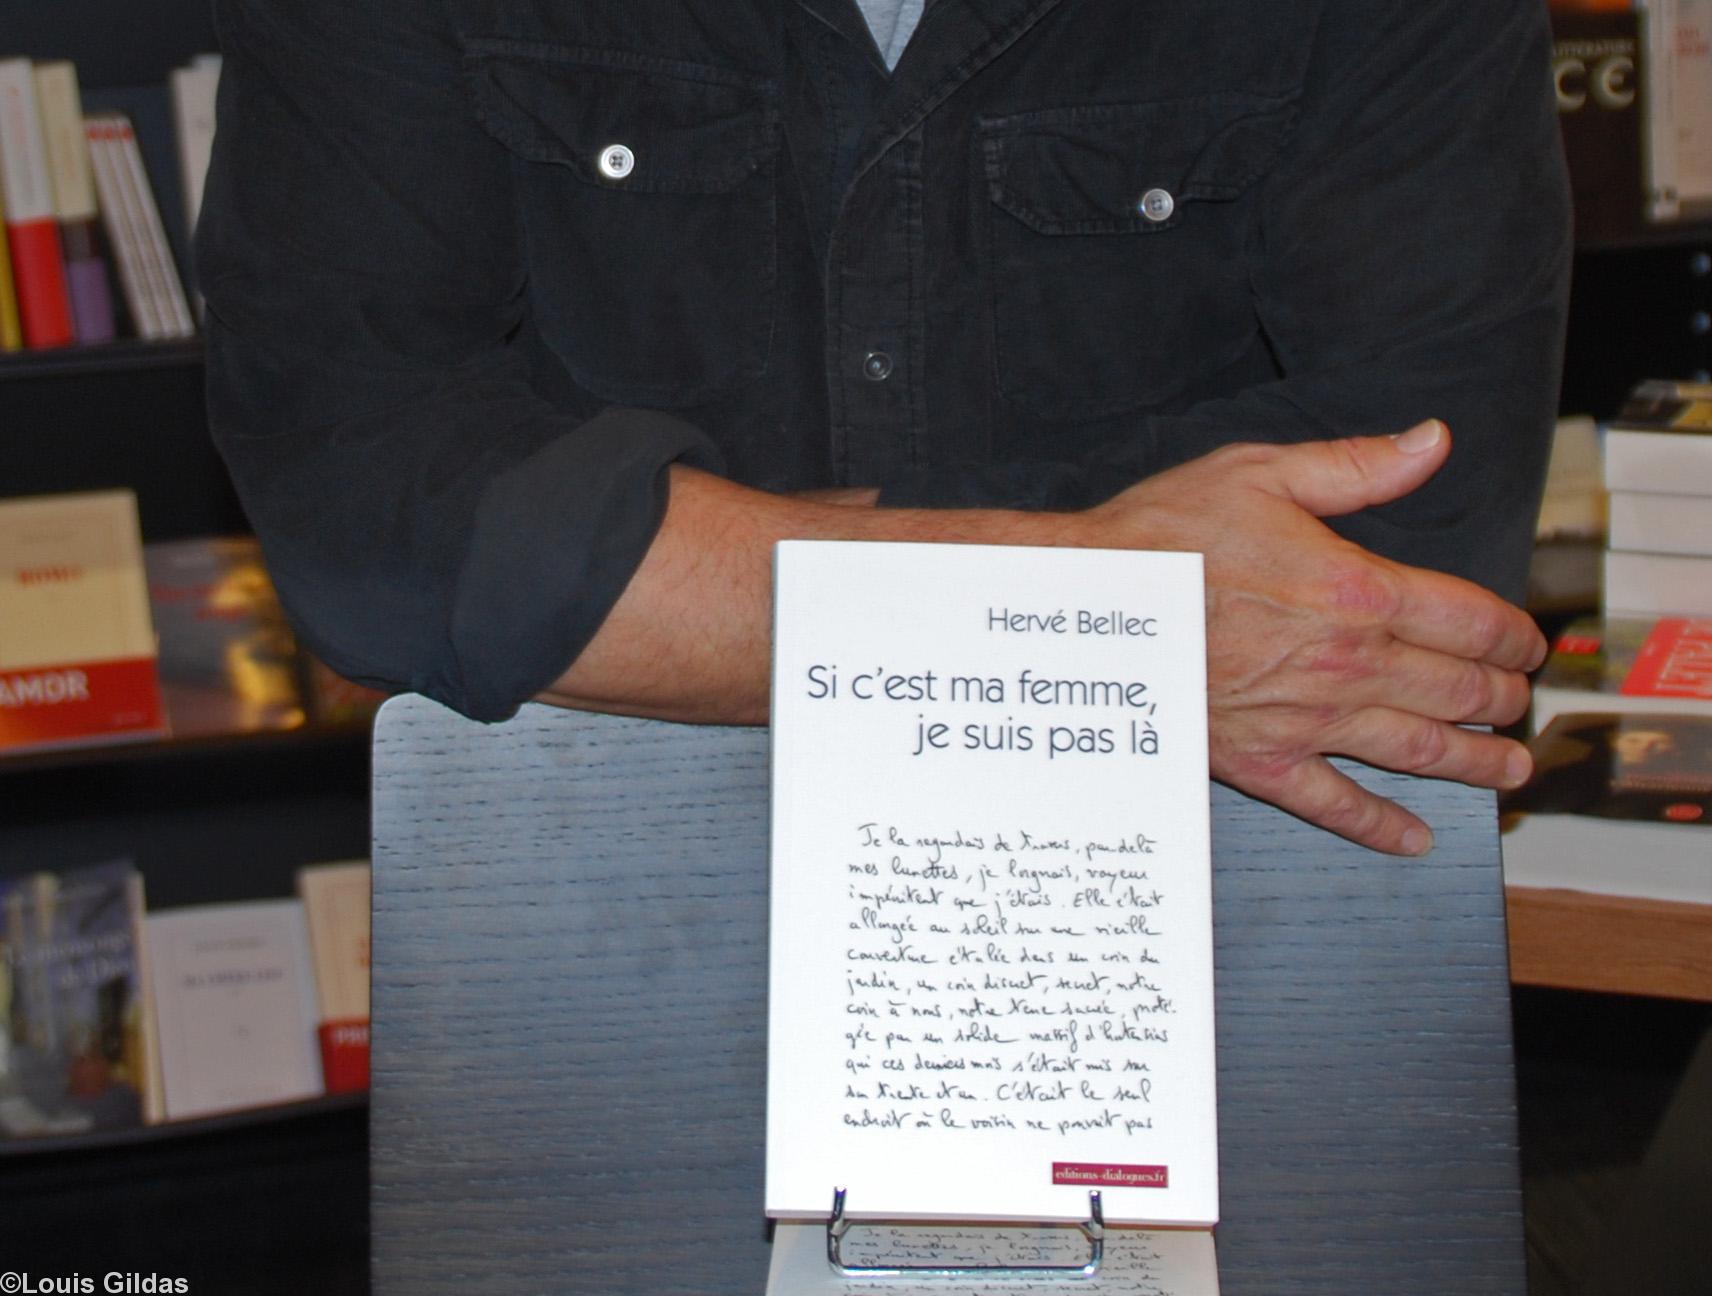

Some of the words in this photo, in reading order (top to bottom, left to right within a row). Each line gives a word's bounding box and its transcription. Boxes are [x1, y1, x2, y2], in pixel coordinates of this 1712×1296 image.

[988, 607, 1066, 634] Hervé
[1077, 610, 1158, 637] Bellec
[807, 665, 837, 699] Si
[951, 674, 1004, 703] ma
[1019, 670, 1158, 715] femme,
[913, 715, 950, 756] je
[964, 717, 1034, 751] suis
[1050, 724, 1115, 759] pas
[1131, 720, 1159, 755] là
[857, 823, 882, 847] Je
[889, 826, 910, 847] la
[916, 830, 985, 864] regardais
[994, 833, 1013, 852] de
[848, 863, 878, 876] mes
[978, 864, 999, 892] je
[1086, 869, 1149, 892] voyeur
[849, 884, 944, 910] impénitent
[954, 897, 988, 911] que
[1073, 888, 1111, 908] Elle
[1117, 885, 1165, 908] était
[849, 907, 918, 943] allongée
[930, 924, 951, 934] au
[961, 914, 1008, 935] soleil
[1015, 923, 1042, 935] sur
[1050, 926, 1086, 936] une
[1095, 915, 1163, 935] vieille
[847, 945, 938, 964] couverture
[1020, 947, 1055, 963] dans
[1068, 952, 1089, 962] un
[1102, 951, 1130, 963] coin
[1140, 948, 1160, 963] du
[917, 979, 938, 991] un
[947, 977, 976, 991] coin
[1117, 972, 1161, 991] notre
[847, 1002, 880, 1017] coin
[888, 1000, 907, 1017] à
[958, 997, 1002, 1017] notre
[1008, 997, 1056, 1015] terre
[845, 1023, 877, 1049] gée
[886, 1032, 912, 1049] par
[923, 1033, 944, 1044] un
[955, 1022, 1020, 1043] solide
[1030, 1019, 1078, 1053] massif
[846, 1055, 870, 1075] qui
[882, 1058, 905, 1071] ces
[914, 1053, 965, 1070] derniers
[971, 1057, 1002, 1071] mois
[1086, 1059, 1113, 1071] mis
[1123, 1059, 1151, 1071] sur
[845, 1085, 869, 1099] son
[878, 1082, 930, 1100] trente
[937, 1080, 959, 1099] et
[1081, 1080, 1104, 1100] le
[1113, 1078, 1151, 1102] seul
[844, 1109, 912, 1129] endroit
[916, 1112, 935, 1127] où
[940, 1108, 966, 1128] le
[971, 1114, 1016, 1129] voisin
[1027, 1119, 1051, 1130] ne
[1058, 1109, 1122, 1135] pouvait
[1125, 1117, 1153, 1135] pas
